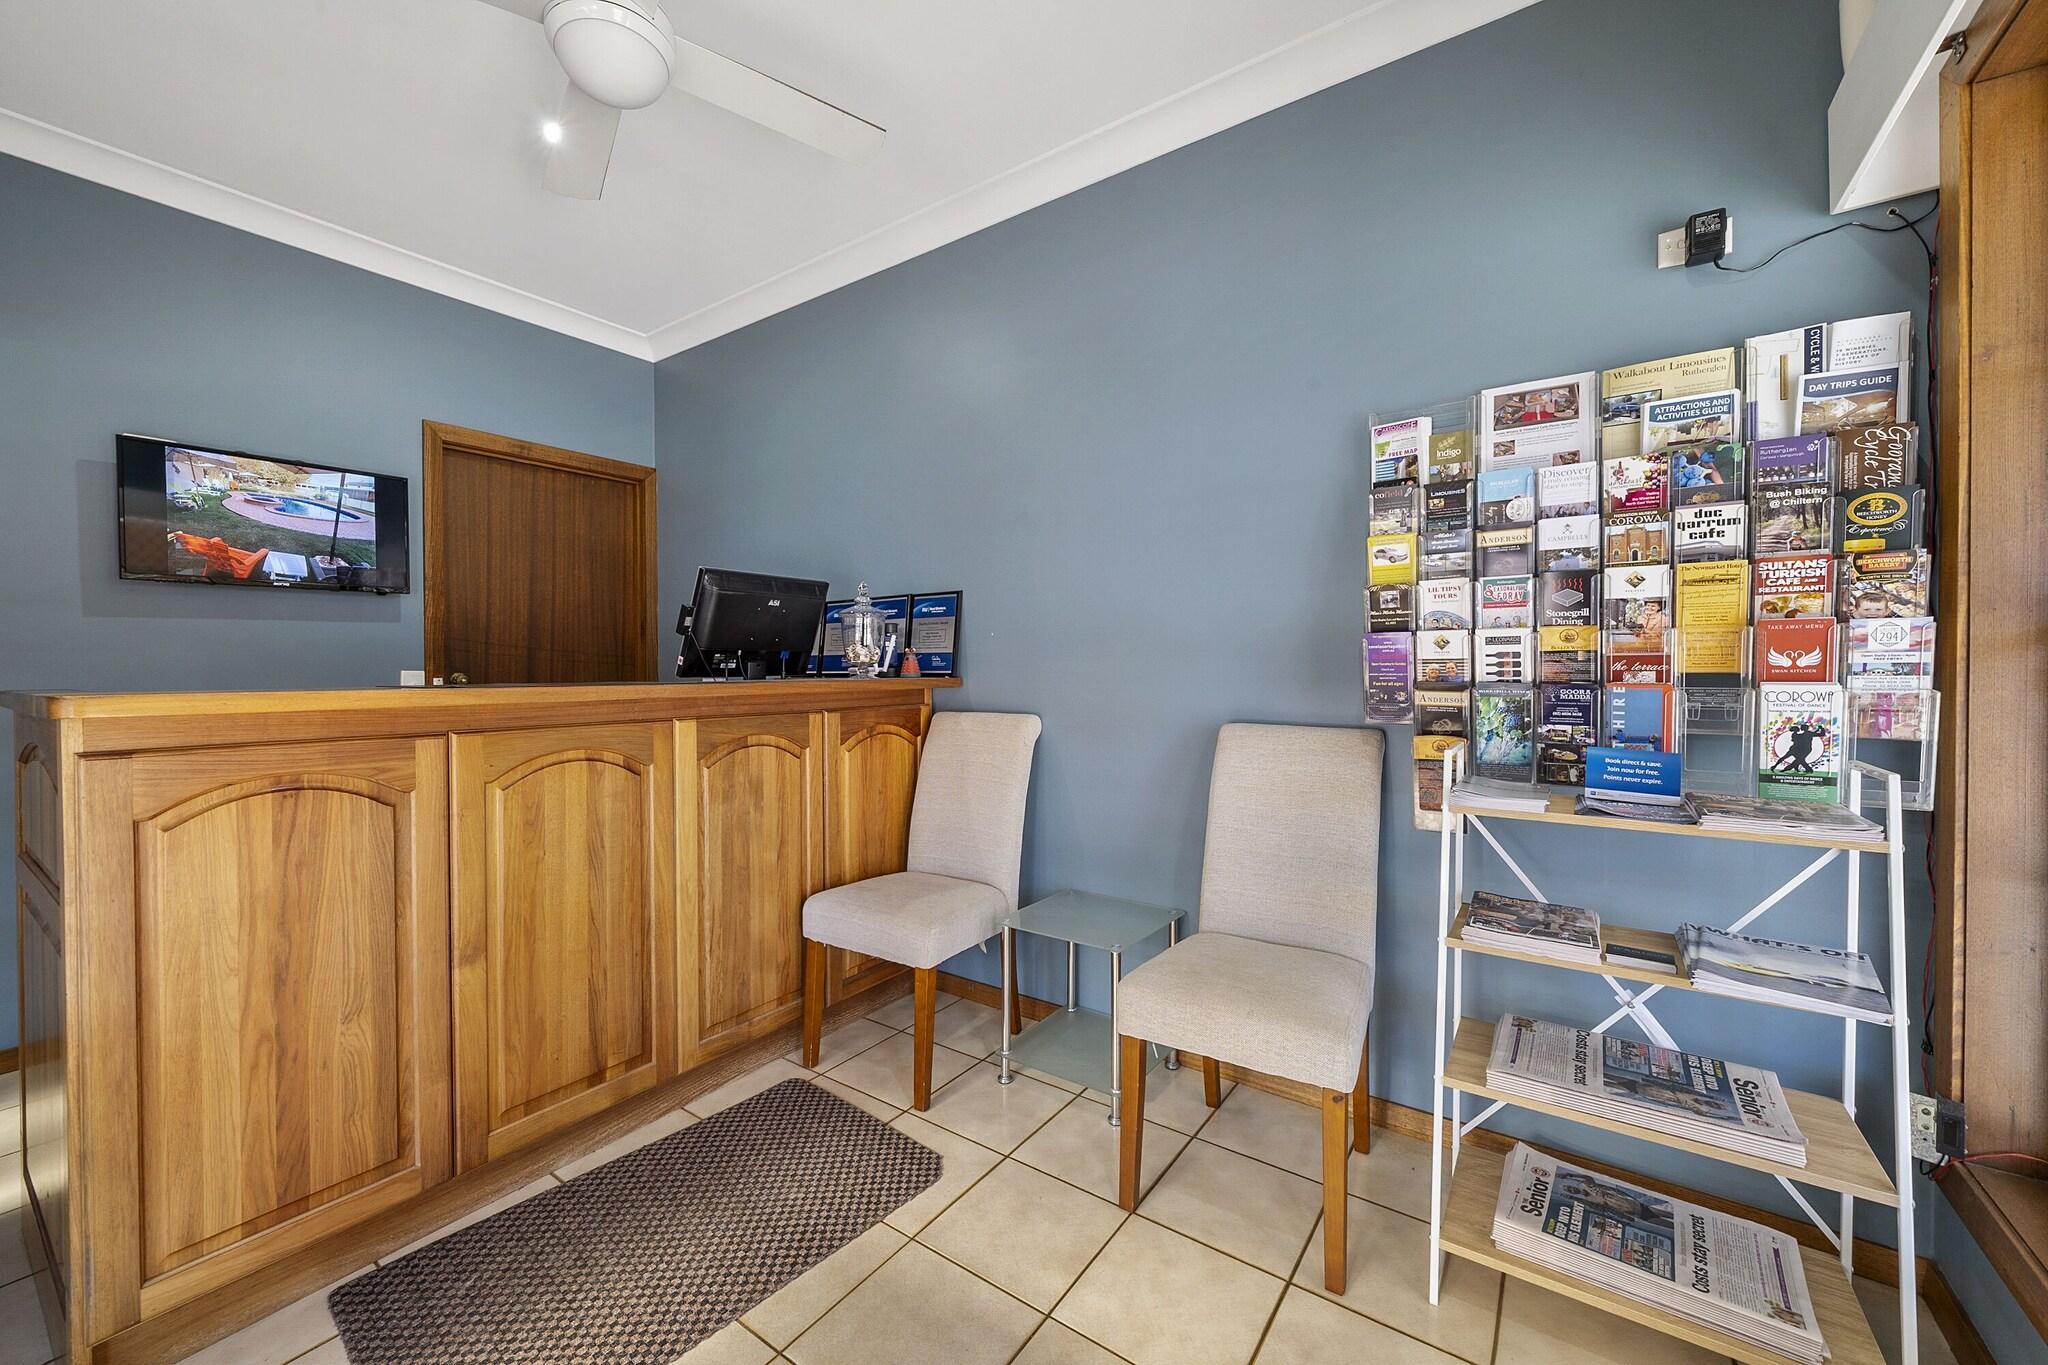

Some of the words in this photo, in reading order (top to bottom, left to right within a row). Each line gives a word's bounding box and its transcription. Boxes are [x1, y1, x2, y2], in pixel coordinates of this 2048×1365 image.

[1810, 329, 1820, 354] CYCLE
[1613, 365, 1666, 380] Walkabout
[1669, 356, 1727, 371] Limousines
[1682, 364, 1727, 377] Rutherglen
[1808, 383, 1828, 393] DAY
[1830, 379, 1857, 390] TRIPS
[1859, 375, 1893, 386] GUIDE
[1655, 400, 1711, 415] ATTRACTIONS
[1711, 397, 1731, 407] AND
[1656, 409, 1701, 421] ACTIVITIES
[1702, 405, 1729, 415] GUIDE
[1388, 450, 1403, 458] FREE
[1404, 447, 1419, 456] MAP
[1436, 448, 1462, 458] Indigo
[1854, 427, 1888, 469] Cycle
[1543, 467, 1590, 479] Discover
[1430, 488, 1466, 497] LIMOUSINES
[1766, 490, 1792, 499] Bush
[1794, 486, 1828, 496] Biking
[1769, 500, 1781, 509] @
[1782, 496, 1823, 506] Chiltern
[1608, 514, 1662, 526] COROWA
[1694, 509, 1722, 519] doc
[1677, 517, 1741, 532] yarrum
[1480, 534, 1528, 545] ANDERSON
[1547, 534, 1588, 543] CAMPBELLS
[1688, 528, 1726, 540] cafe
[1759, 559, 1827, 571] SULTANS
[1855, 556, 1914, 566] BEECHWORTH
[1758, 568, 1826, 579] TURKISH
[1766, 576, 1801, 586] CAFE
[1441, 585, 1462, 593] TIPSY
[1497, 591, 1523, 600] FORAY
[1758, 585, 1826, 594] RESTAURANT
[1546, 608, 1590, 618] Stonegrill
[1879, 631, 1899, 642] 294
[1612, 659, 1629, 671] the
[1631, 660, 1669, 672] terrace
[1419, 694, 1465, 704] ANDERSON
[1764, 690, 1834, 703] COROWA
[1612, 686, 1626, 729] HIRE
[1605, 757, 1620, 765] Book
[1621, 758, 1640, 766] direct
[1603, 774, 1622, 782] Points
[1635, 767, 1644, 775] for
[1645, 768, 1661, 776] free.
[1705, 925, 1813, 953] WHAT'S
[1574, 1029, 1592, 1050] Costs
[1571, 1049, 1590, 1065] stay
[1686, 1054, 1700, 1067] HIS
[1700, 1056, 1716, 1075] DEEP
[1573, 1063, 1589, 1087] secret
[1689, 1066, 1707, 1095] ELEMENT
[1703, 1074, 1719, 1091] INTO
[1732, 1078, 1767, 1120] Senior
[1519, 1176, 1551, 1217] Senior
[1556, 1206, 1571, 1224] INTO
[1569, 1200, 1585, 1233] ELEMENT
[1554, 1223, 1568, 1239] DEEP
[1689, 1213, 1707, 1243] secret
[1567, 1231, 1581, 1243] HIS
[1692, 1242, 1710, 1267] stay
[1691, 1267, 1710, 1294] Costs
